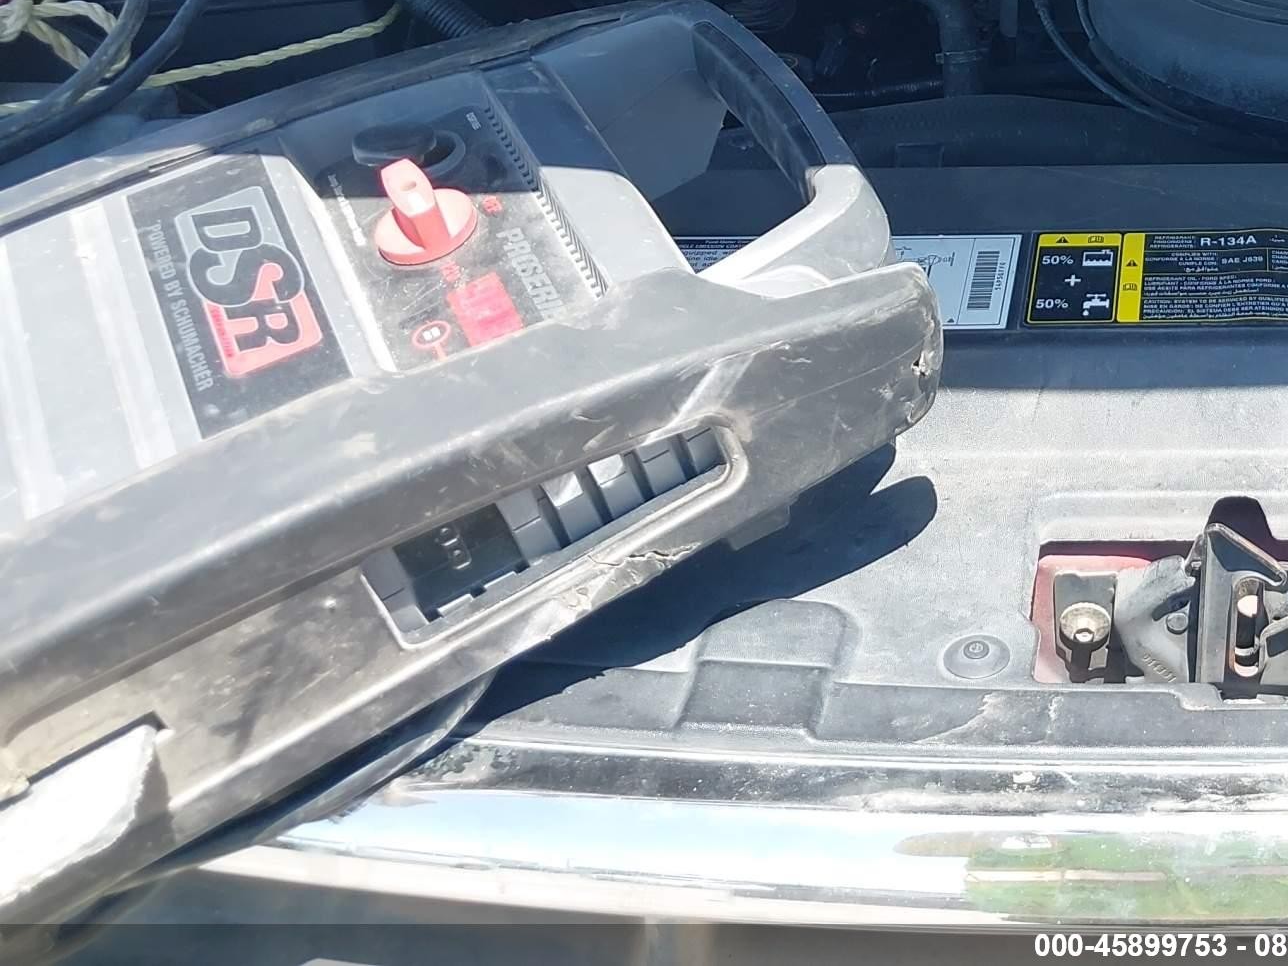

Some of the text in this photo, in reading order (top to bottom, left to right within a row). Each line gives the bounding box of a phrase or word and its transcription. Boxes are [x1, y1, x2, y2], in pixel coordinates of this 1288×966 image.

[1200, 235, 1257, 247] R-134A
[1041, 255, 1074, 265] 50%
[187, 204, 305, 353] DSR
[149, 223, 215, 392] POWERED BY SCHUMACHER
[1035, 298, 1069, 309] 50%
